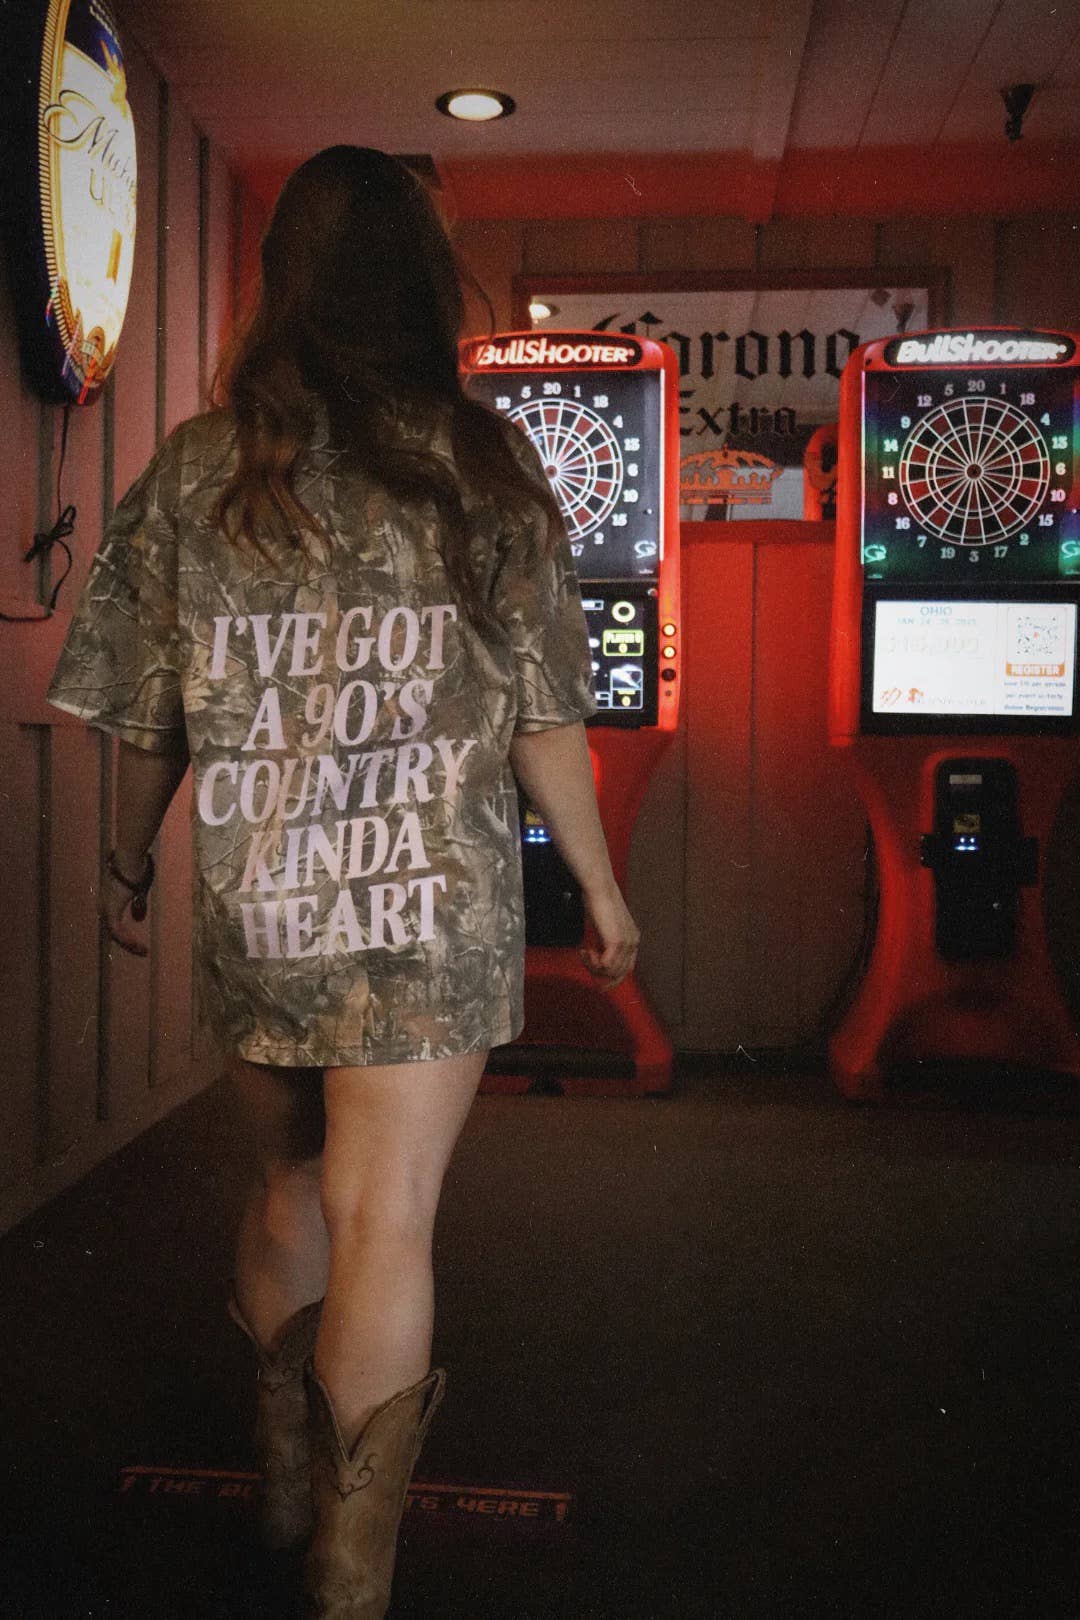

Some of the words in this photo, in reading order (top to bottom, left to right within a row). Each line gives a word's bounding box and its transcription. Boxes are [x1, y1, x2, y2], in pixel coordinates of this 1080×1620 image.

[520, 385, 532, 400] 5
[573, 385, 582, 398] 1
[944, 383, 954, 397] 5
[967, 379, 986, 392] 20
[999, 382, 1007, 395] 1
[917, 394, 932, 408] 12
[1020, 392, 1036, 407] 18
[612, 415, 624, 429] 4
[900, 415, 911, 429] 9
[1040, 412, 1051, 426] 4
[883, 438, 899, 453] 14
[881, 465, 895, 479] 11
[1055, 461, 1066, 476] 6
[887, 491, 899, 506] 8
[1050, 488, 1066, 502] 10
[895, 516, 911, 530] 16
[1038, 513, 1054, 527] 15
[916, 534, 928, 548] 7
[1018, 533, 1030, 546] 2
[940, 546, 956, 559] 19
[968, 550, 980, 563] 3
[994, 545, 1009, 558] 17
[920, 605, 953, 616] OHIO
[207, 612, 328, 680] I'VE
[335, 604, 457, 673] GOT
[241, 687, 288, 751] A
[302, 679, 434, 748] 90'S
[197, 738, 478, 826] COUNTRY
[238, 812, 432, 893] KINDA
[240, 874, 447, 959] HEART
